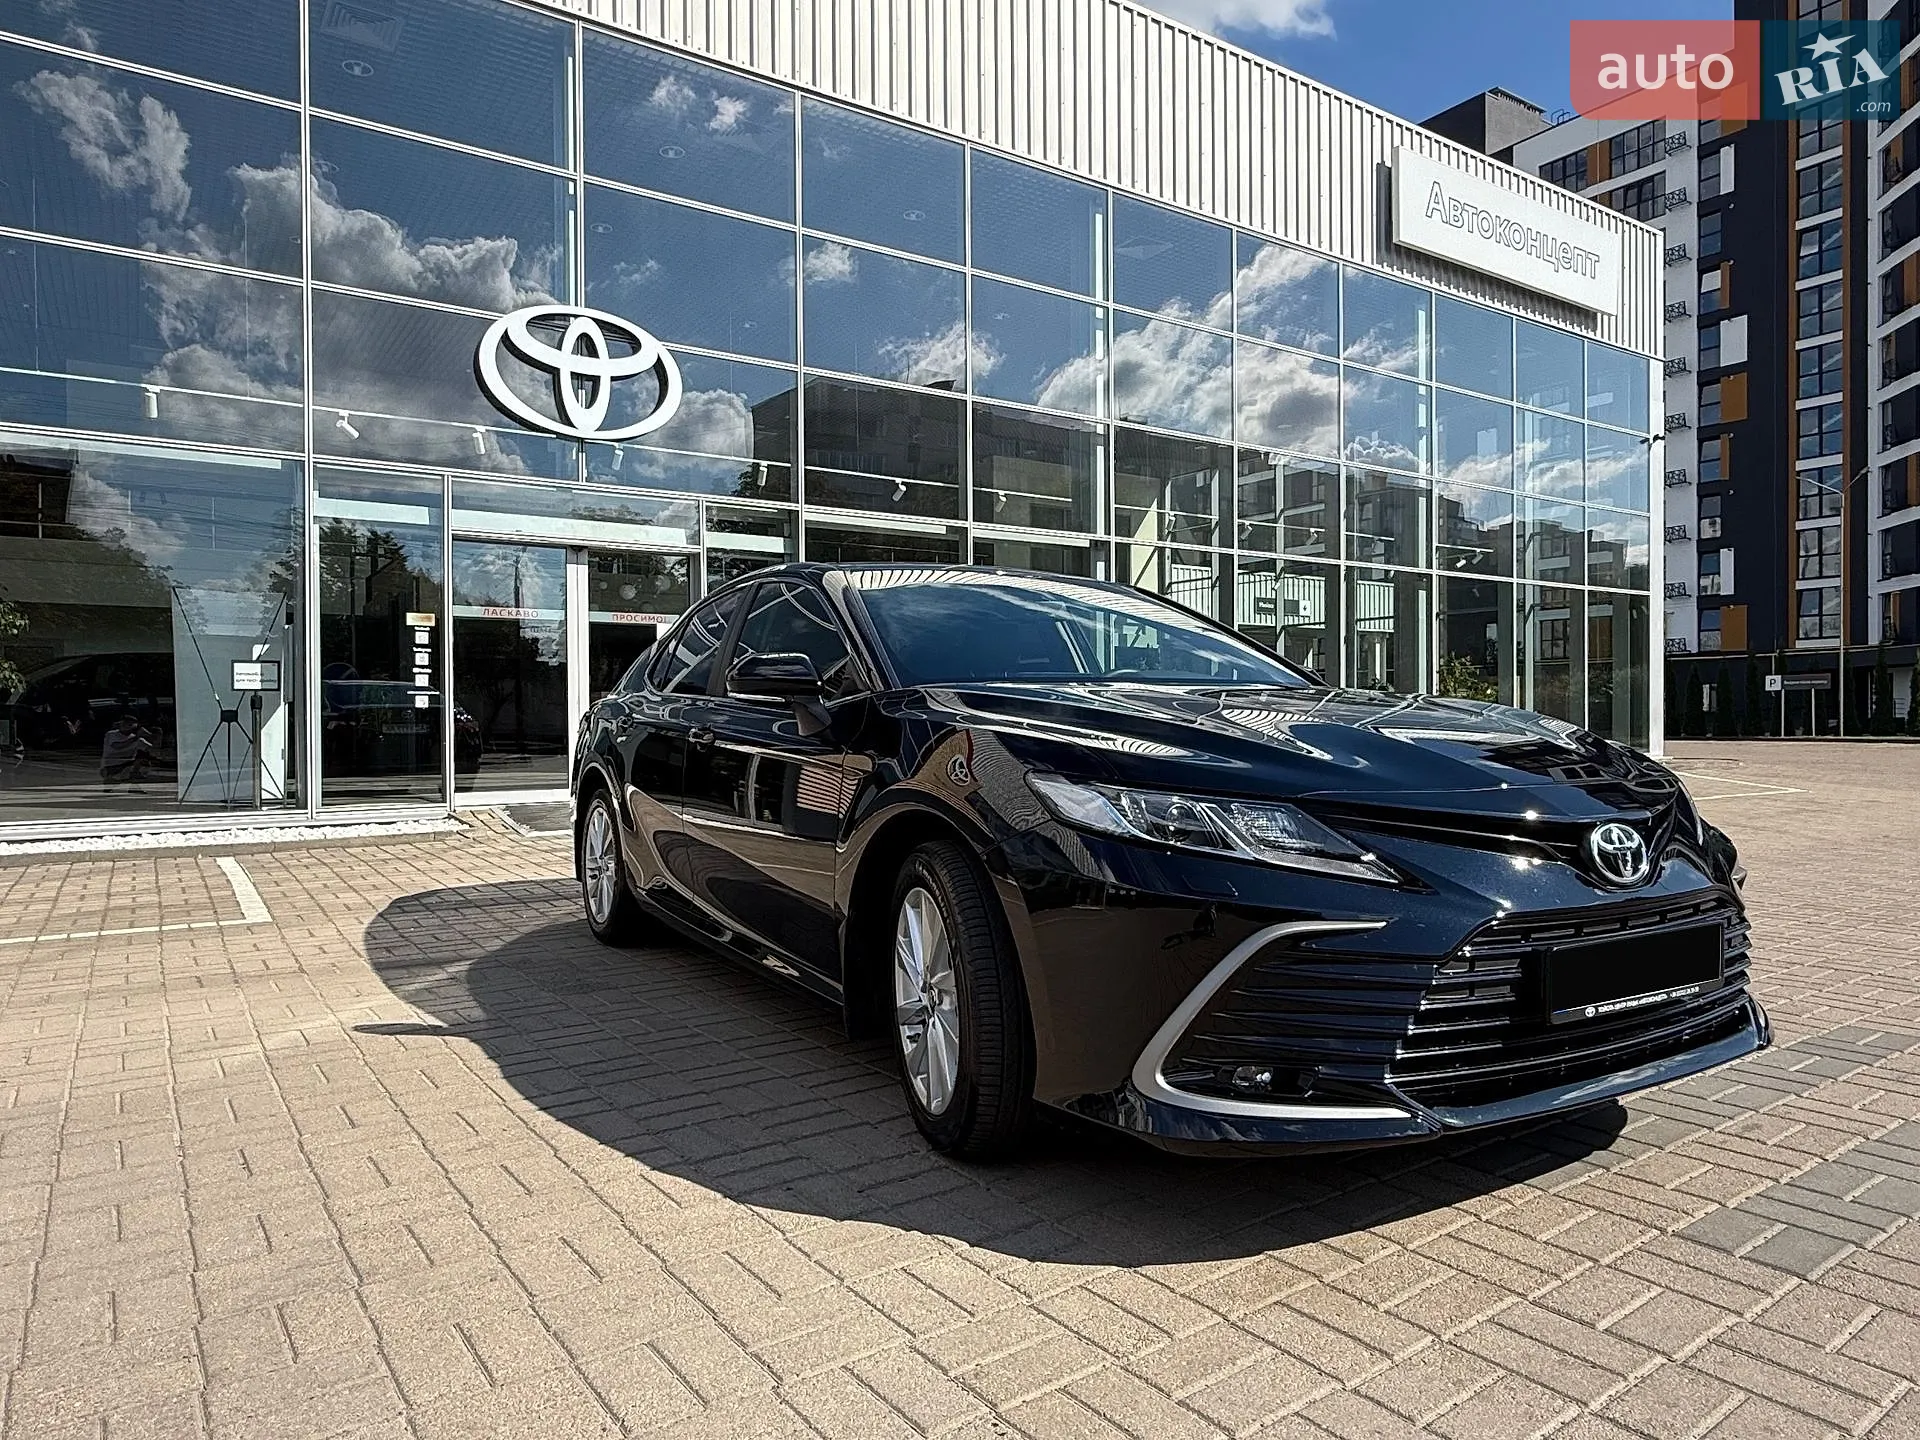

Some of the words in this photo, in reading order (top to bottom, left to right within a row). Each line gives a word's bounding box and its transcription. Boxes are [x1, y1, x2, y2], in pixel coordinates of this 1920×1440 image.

[1425, 181, 1600, 279] Автоконцепт
[482, 608, 539, 618] ЛАСКАВО
[1769, 678, 1777, 688] P
